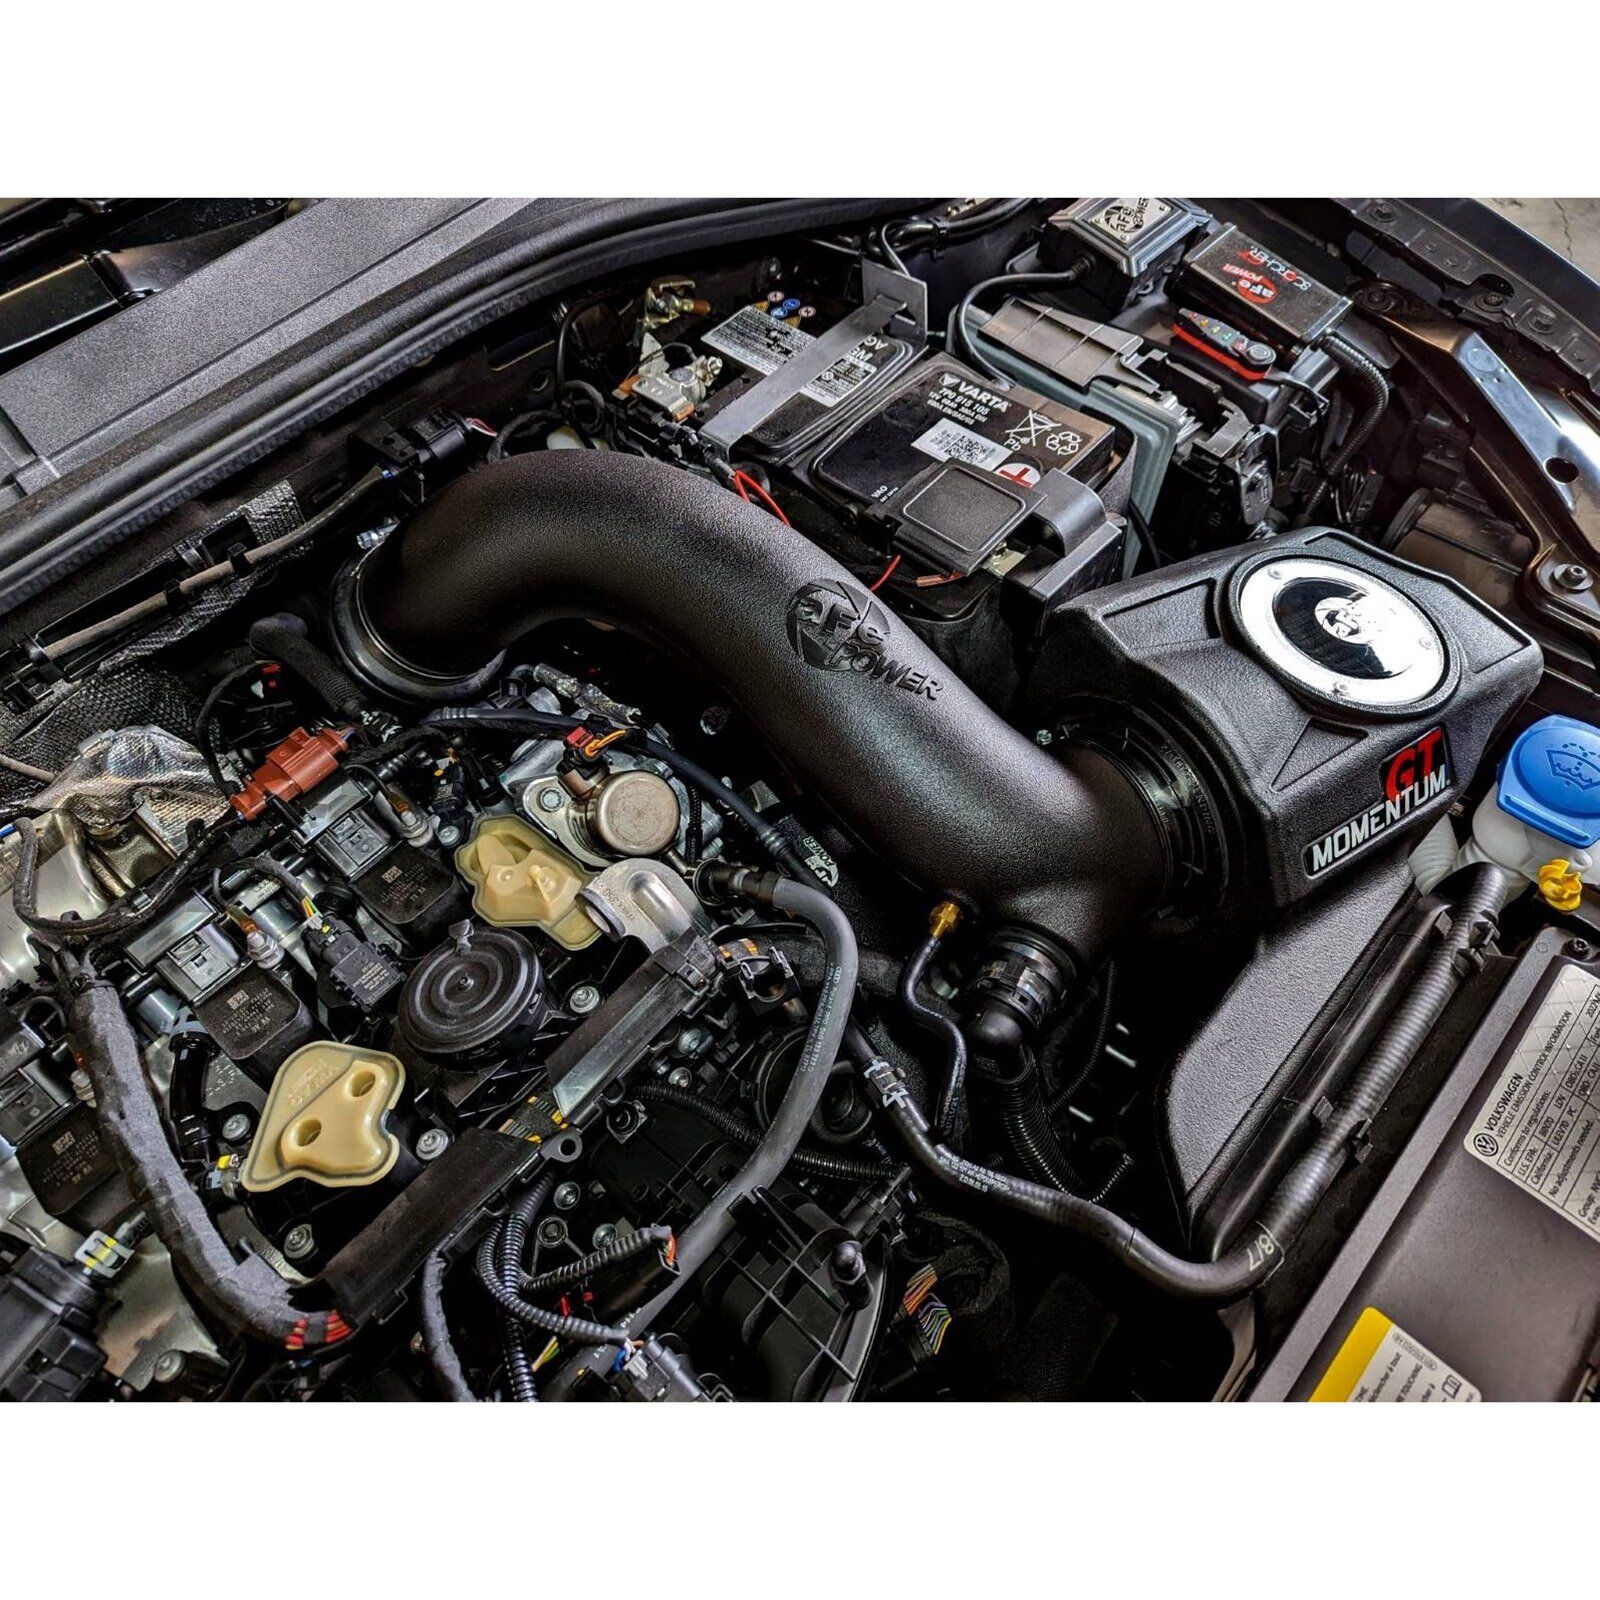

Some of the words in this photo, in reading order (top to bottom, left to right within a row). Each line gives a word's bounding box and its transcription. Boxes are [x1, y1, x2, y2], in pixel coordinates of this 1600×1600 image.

[957, 380, 1009, 413] VARTA
[972, 402, 990, 416] 105
[1003, 436, 1022, 452] Pb
[825, 643, 944, 701] POWER
[1385, 731, 1442, 801] GT
[1313, 765, 1447, 872] MOMENTUM
[1495, 1110, 1515, 1139] VEHICLE
[1510, 1079, 1532, 1112] EMISSION
[1527, 1051, 1549, 1081] CONTROL
[1543, 1009, 1572, 1053] INFORMATION
[1483, 1072, 1523, 1132] VOLKSWAGEN
[1566, 1105, 1577, 1117] PC
[1503, 1132, 1526, 1166] Conforms
[1529, 1148, 1554, 1185] California:
[1553, 1143, 1581, 1187] adjustments
[1517, 1160, 1530, 1176] U.S.
[1548, 1184, 1559, 1197] No
